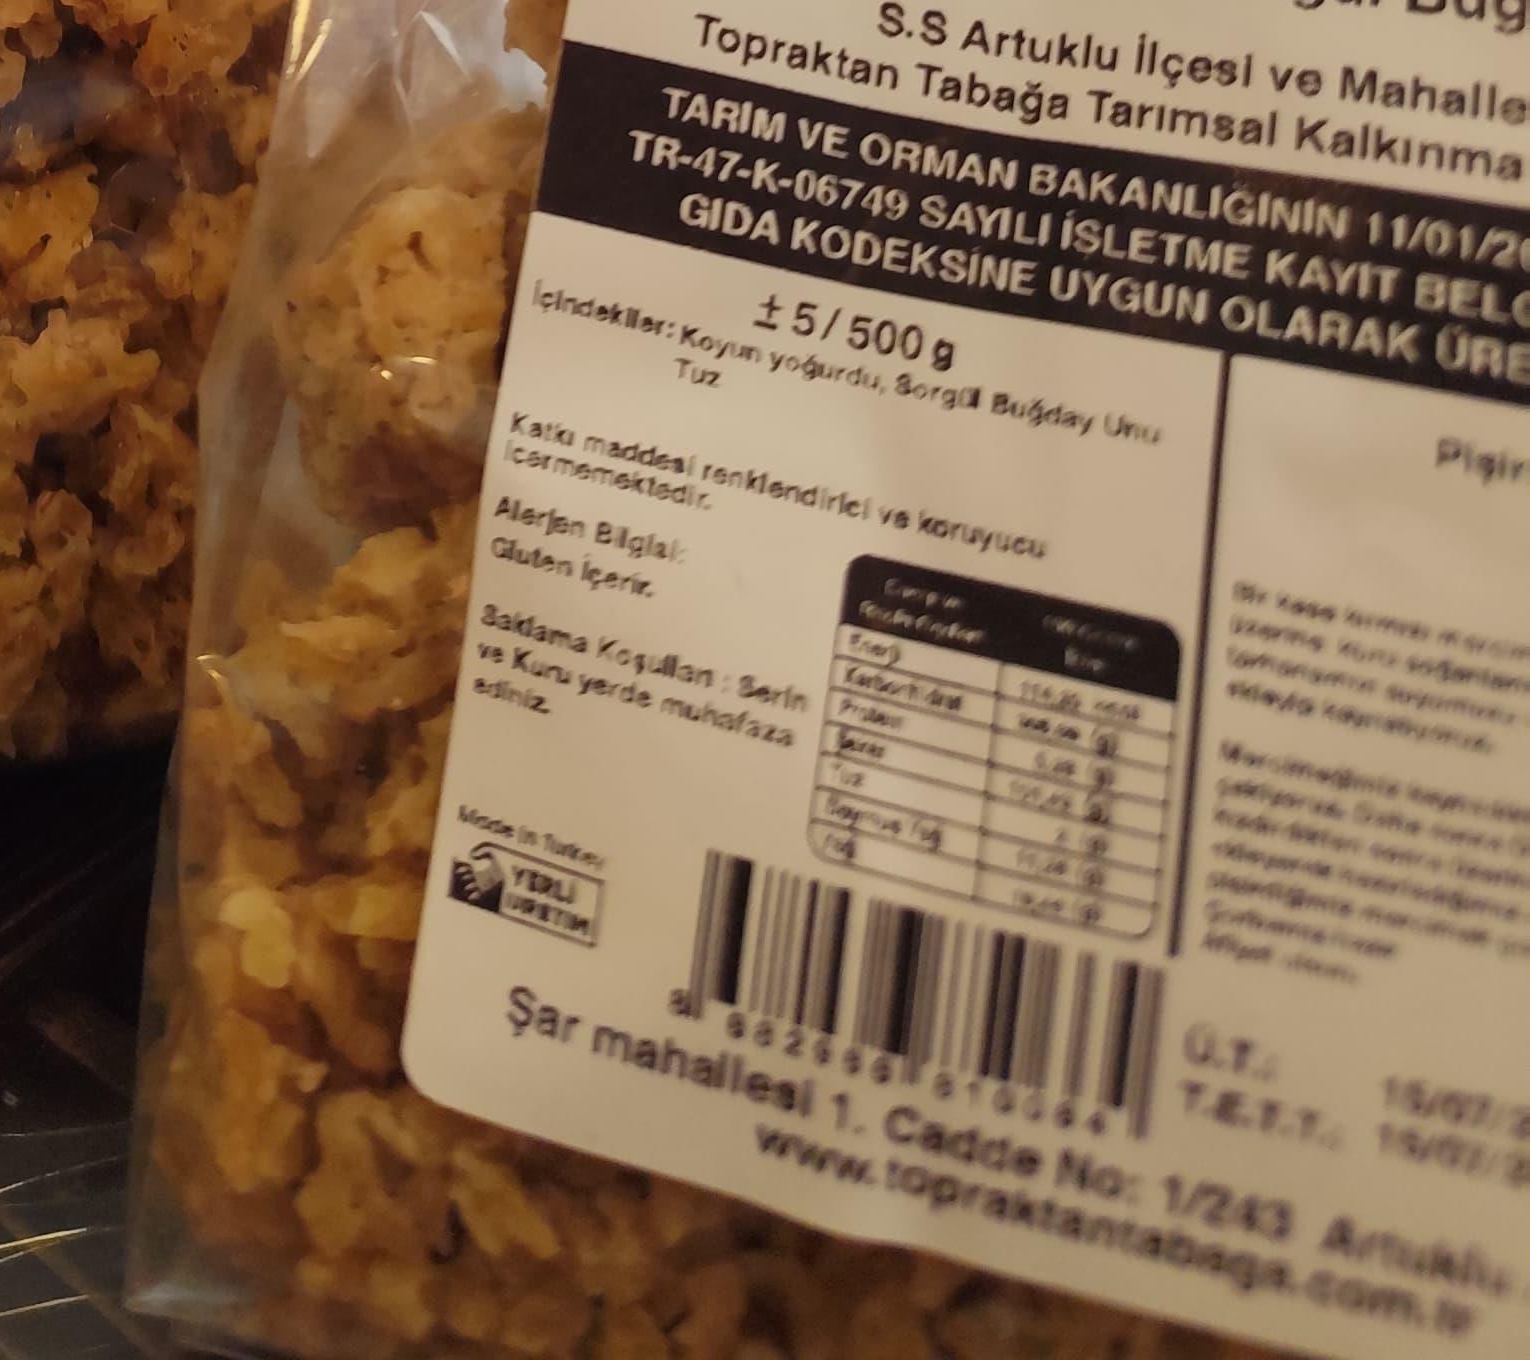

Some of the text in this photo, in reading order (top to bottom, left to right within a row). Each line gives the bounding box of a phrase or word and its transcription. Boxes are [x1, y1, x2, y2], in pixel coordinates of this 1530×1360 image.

[694, 12, 1524, 182] Topraktan Tabağa Tarımsal Kalkınma
[877, 1, 1529, 127] S.S Artuklu İlçesi ve Mahalle
[661, 85, 789, 145] TARIM
[797, 116, 851, 161] VE
[859, 131, 1020, 192] ORMAN
[628, 128, 911, 222] TR-47-K-06749
[918, 193, 1054, 248] SAYILI
[1060, 208, 1255, 281] İŞLETME
[1266, 248, 1406, 306] KAYIT
[678, 192, 782, 247] GIDA
[790, 217, 1040, 298] KODEKSİNE
[1049, 263, 1212, 326] UYGUN
[1219, 293, 1425, 366] OLARAK
[674, 356, 723, 389] Tuz
[678, 323, 763, 364] Koyun
[990, 391, 1097, 437] Buğday
[506, 983, 581, 1038] Şar
[592, 1016, 816, 1118] mahallesi
[883, 1103, 1043, 1176] Cadde
